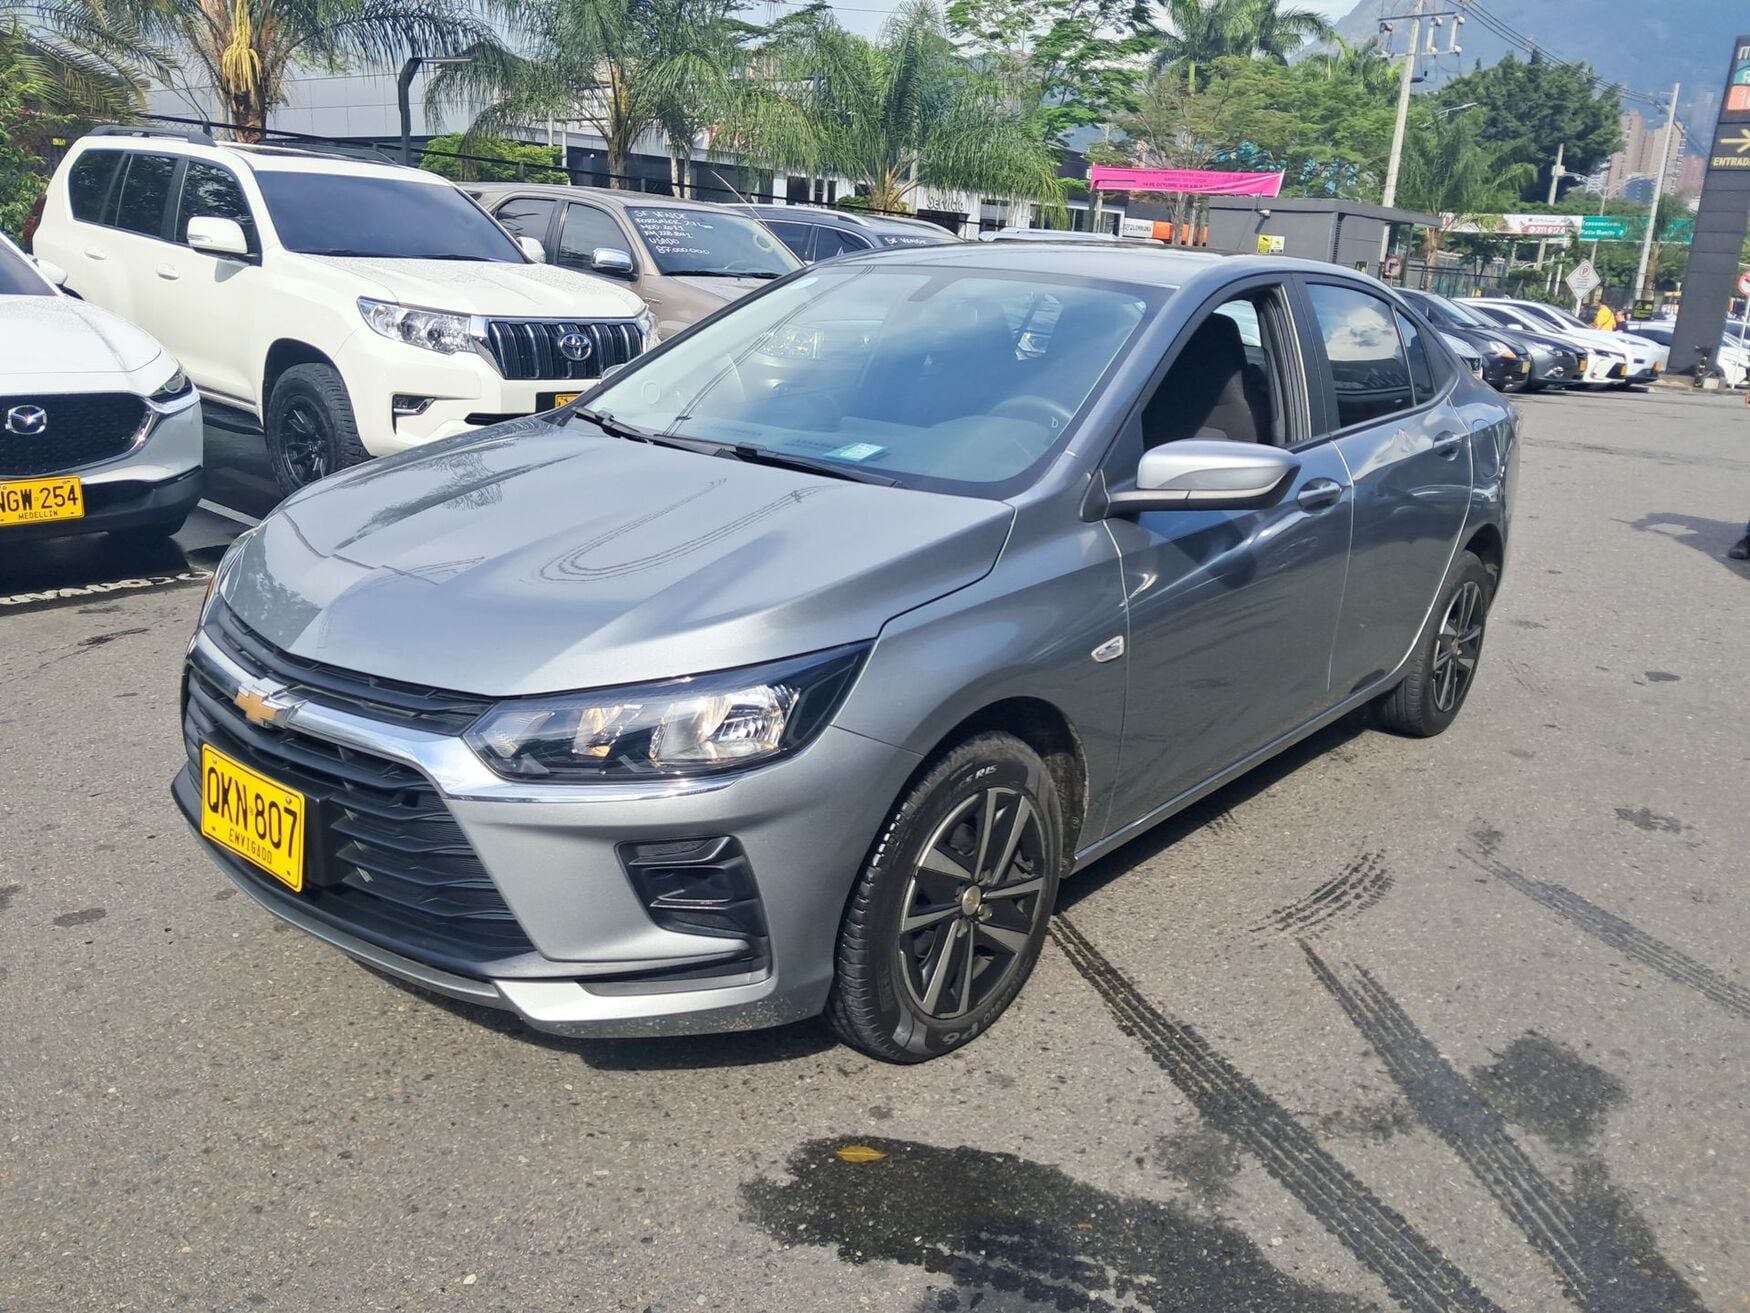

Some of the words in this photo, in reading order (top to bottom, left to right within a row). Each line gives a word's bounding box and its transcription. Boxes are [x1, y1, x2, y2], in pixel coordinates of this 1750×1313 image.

[1713, 157, 1750, 167] ENTRAD
[927, 194, 964, 211] Servicio
[653, 211, 688, 219] VENDE
[39, 484, 78, 509] 254
[18, 510, 58, 520] MEDELLIN
[207, 767, 248, 832] QKN
[254, 792, 298, 859] 807
[229, 828, 273, 865] ENVIGADO
